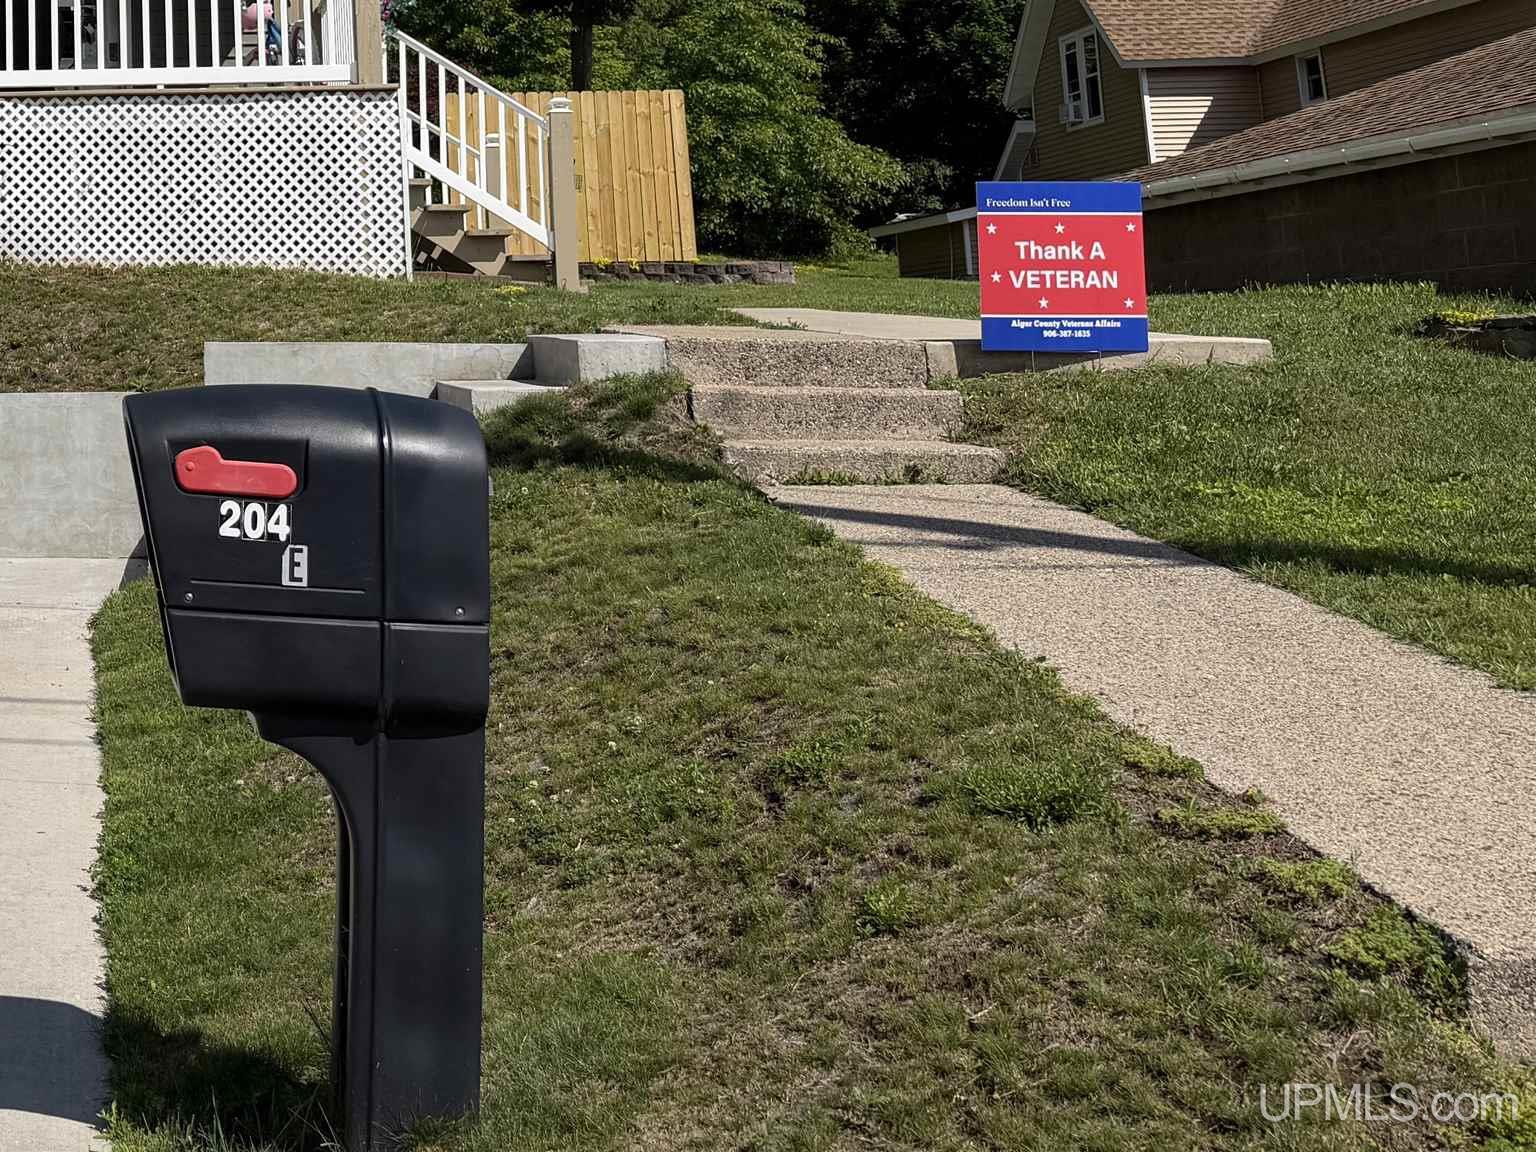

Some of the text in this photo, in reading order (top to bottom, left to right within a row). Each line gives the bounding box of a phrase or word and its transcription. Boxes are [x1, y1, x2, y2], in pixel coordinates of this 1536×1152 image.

[986, 198, 1072, 208] Freedom Isn't Free
[1014, 240, 1106, 260] Thank A
[1008, 270, 1118, 289] VETERAN
[1033, 319, 1060, 329] County
[1062, 319, 1094, 328] Veterans
[1095, 319, 1121, 328] Affairs
[218, 499, 291, 542] 204
[286, 546, 306, 585] E
